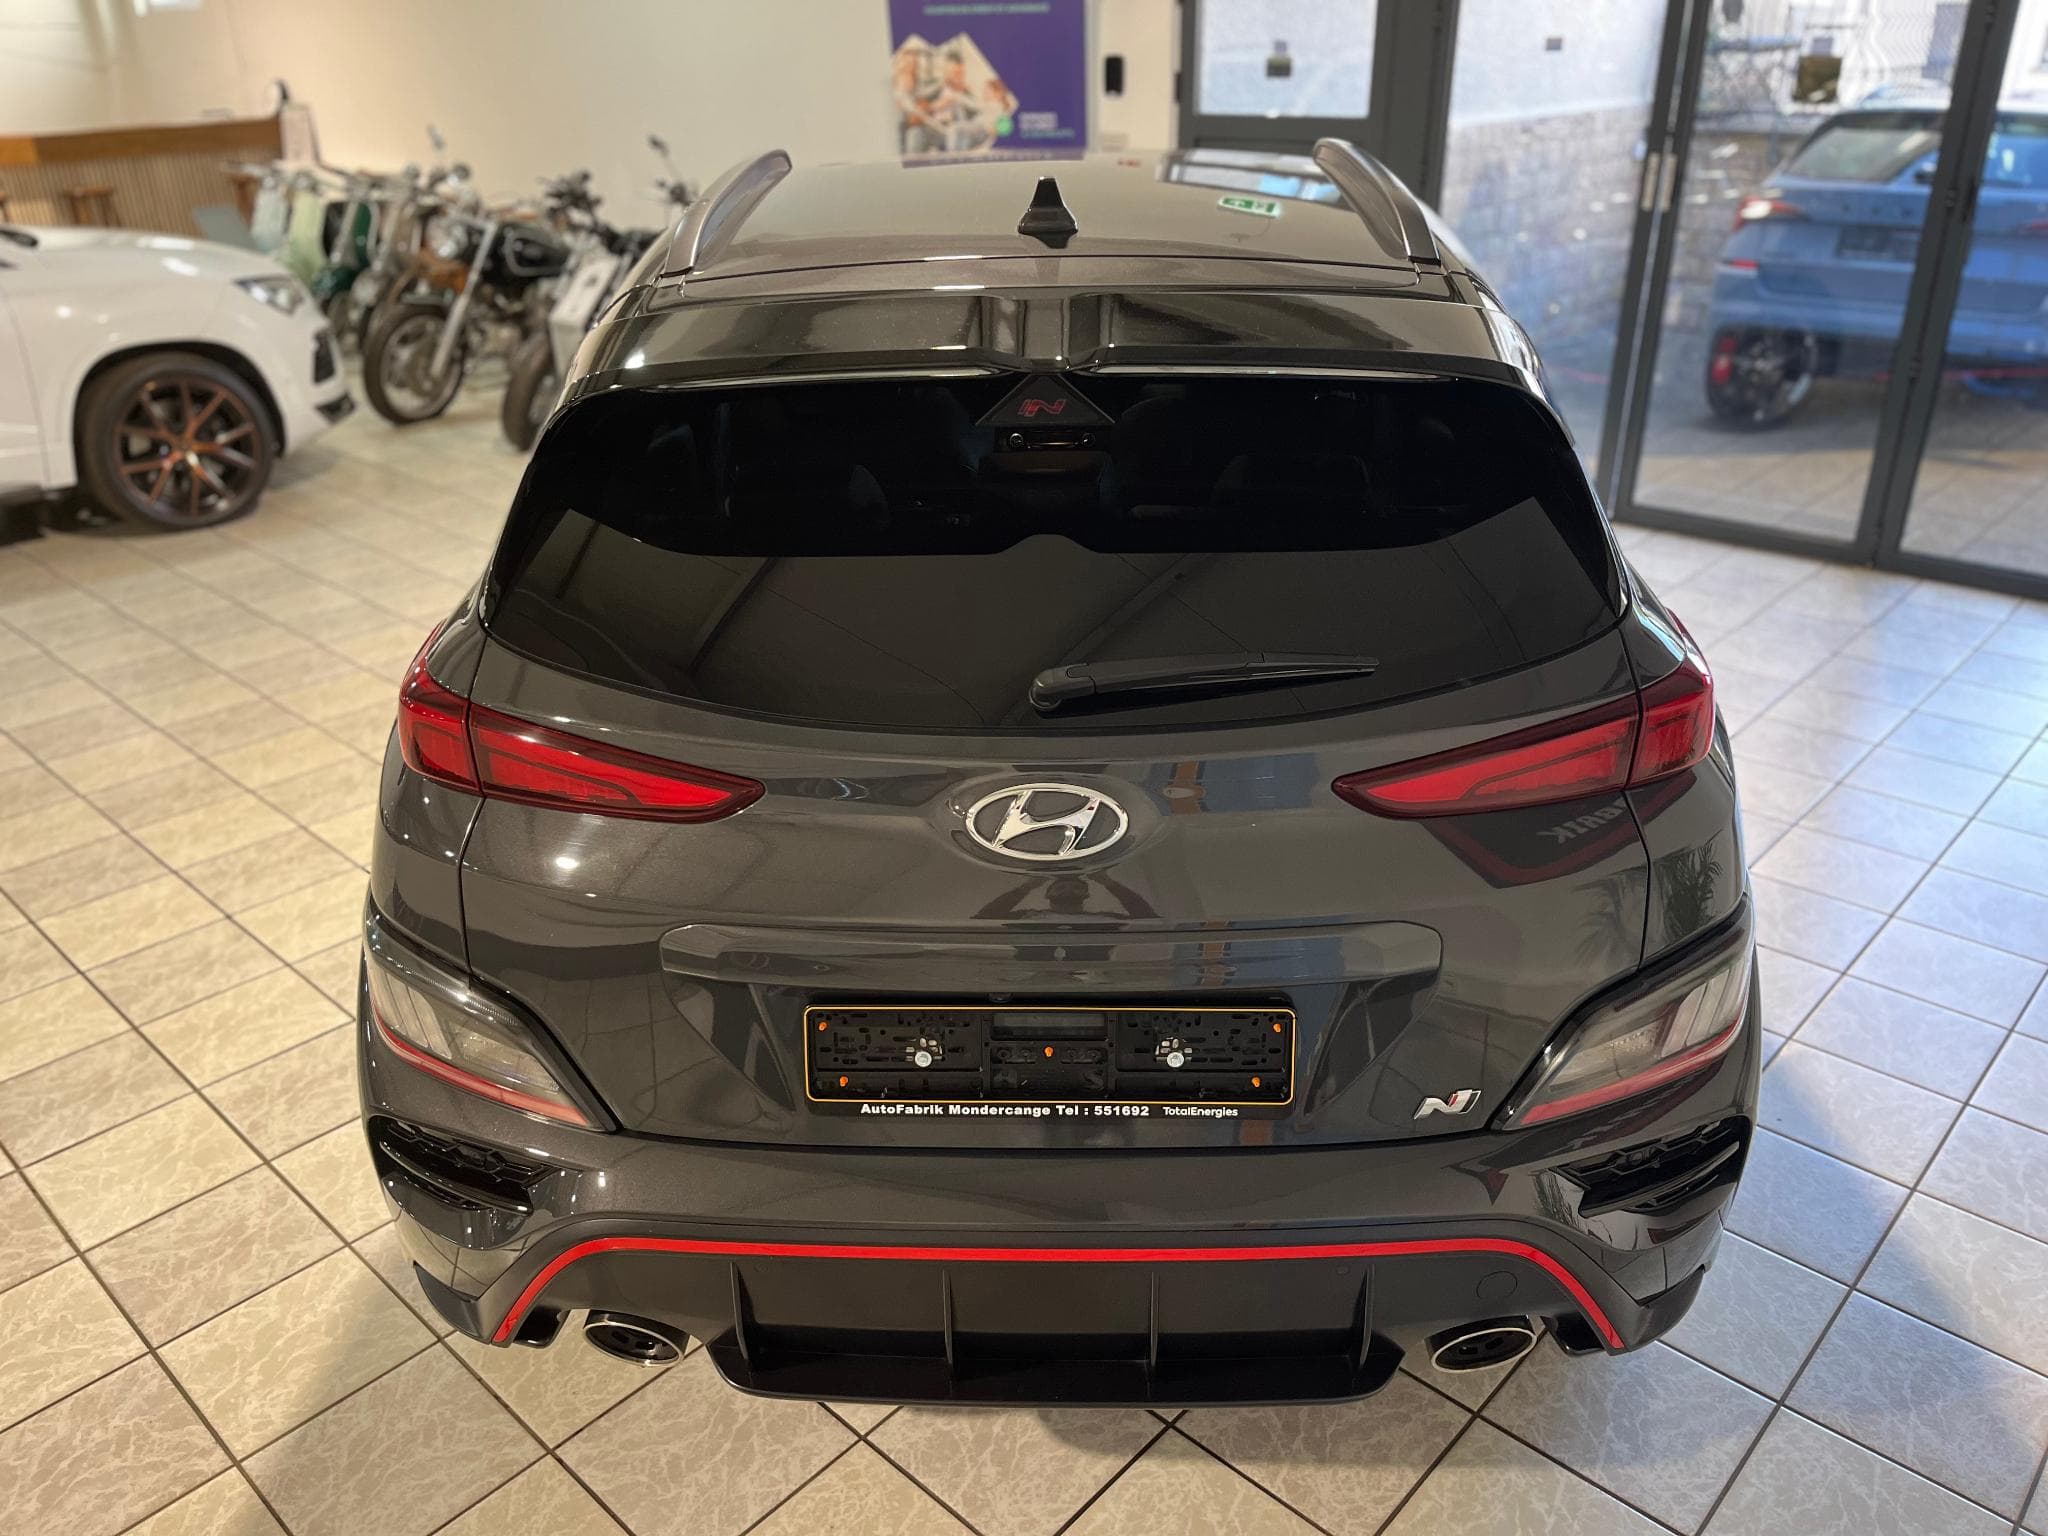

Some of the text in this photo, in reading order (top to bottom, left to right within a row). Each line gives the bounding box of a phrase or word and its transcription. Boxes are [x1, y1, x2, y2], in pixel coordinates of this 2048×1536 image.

[860, 1103, 944, 1115] AutoFabrik
[948, 1104, 1051, 1118] Mondercange
[1055, 1104, 1079, 1116] Tel
[1093, 1104, 1150, 1117] 551692
[1162, 1106, 1239, 1119] TotalEnergies
